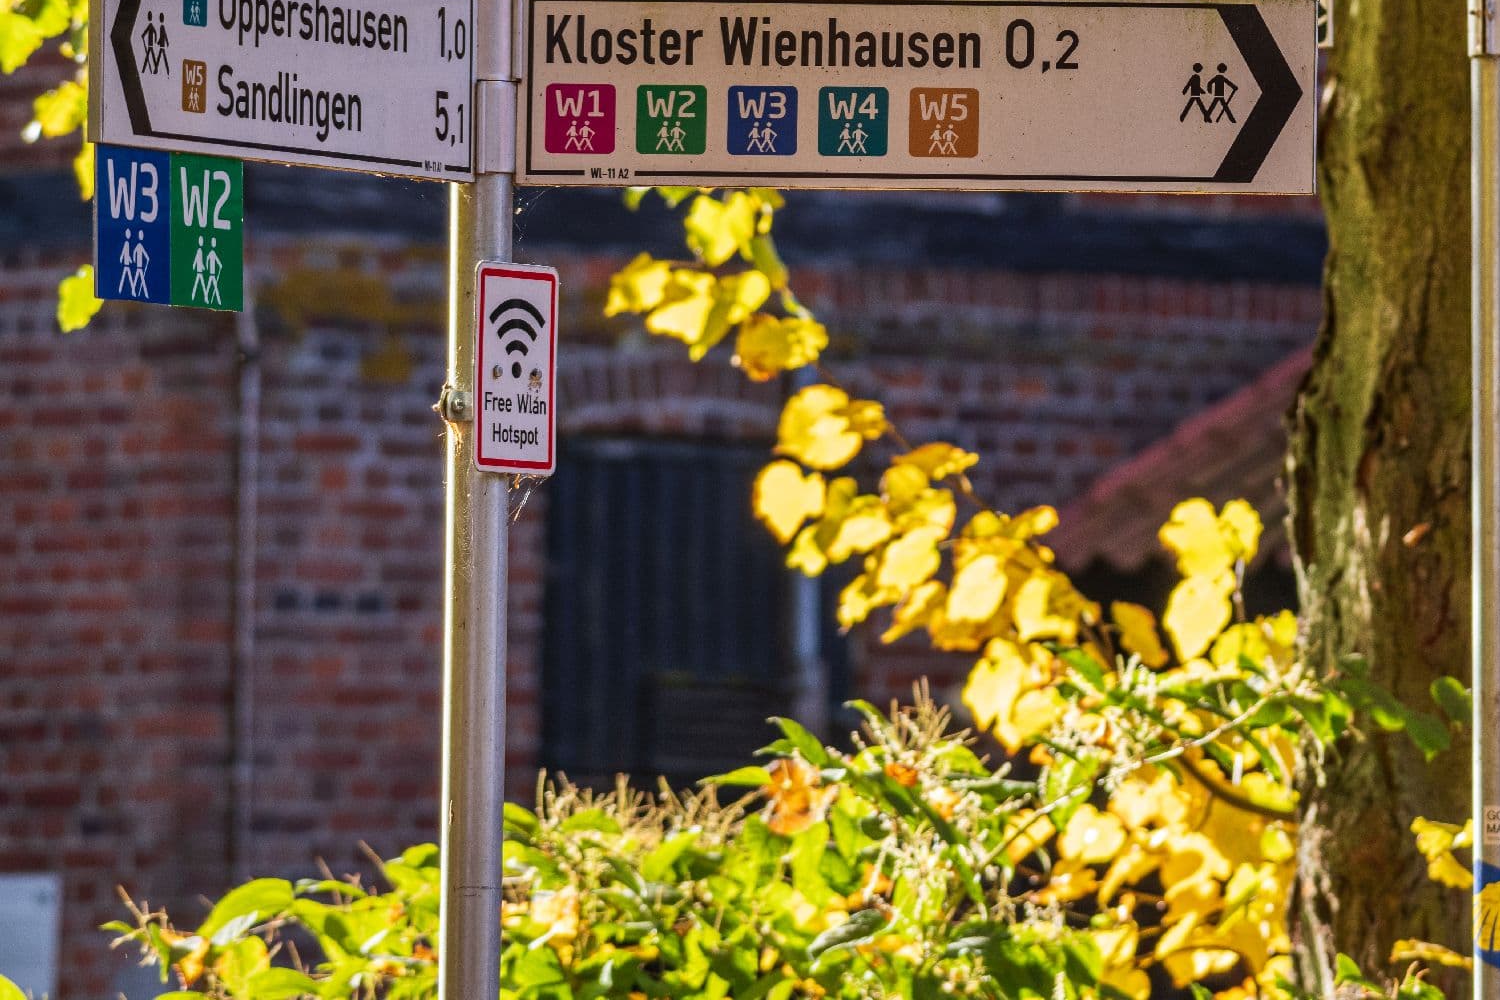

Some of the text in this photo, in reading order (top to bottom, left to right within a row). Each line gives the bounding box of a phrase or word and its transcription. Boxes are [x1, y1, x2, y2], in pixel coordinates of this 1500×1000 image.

[437, 6, 466, 62] 1,0
[545, 14, 1080, 74] Kloster Wienhausen 0,2
[185, 63, 464, 147] W5 Sandlingen 5,1
[555, 89, 606, 118] W1
[646, 90, 697, 119] W2
[737, 91, 788, 120] W3
[828, 92, 879, 121] W4
[919, 93, 969, 122] W5
[107, 158, 159, 223] W3
[180, 166, 232, 231] W2
[484, 391, 513, 413] Free
[492, 423, 539, 449] Hotspot
